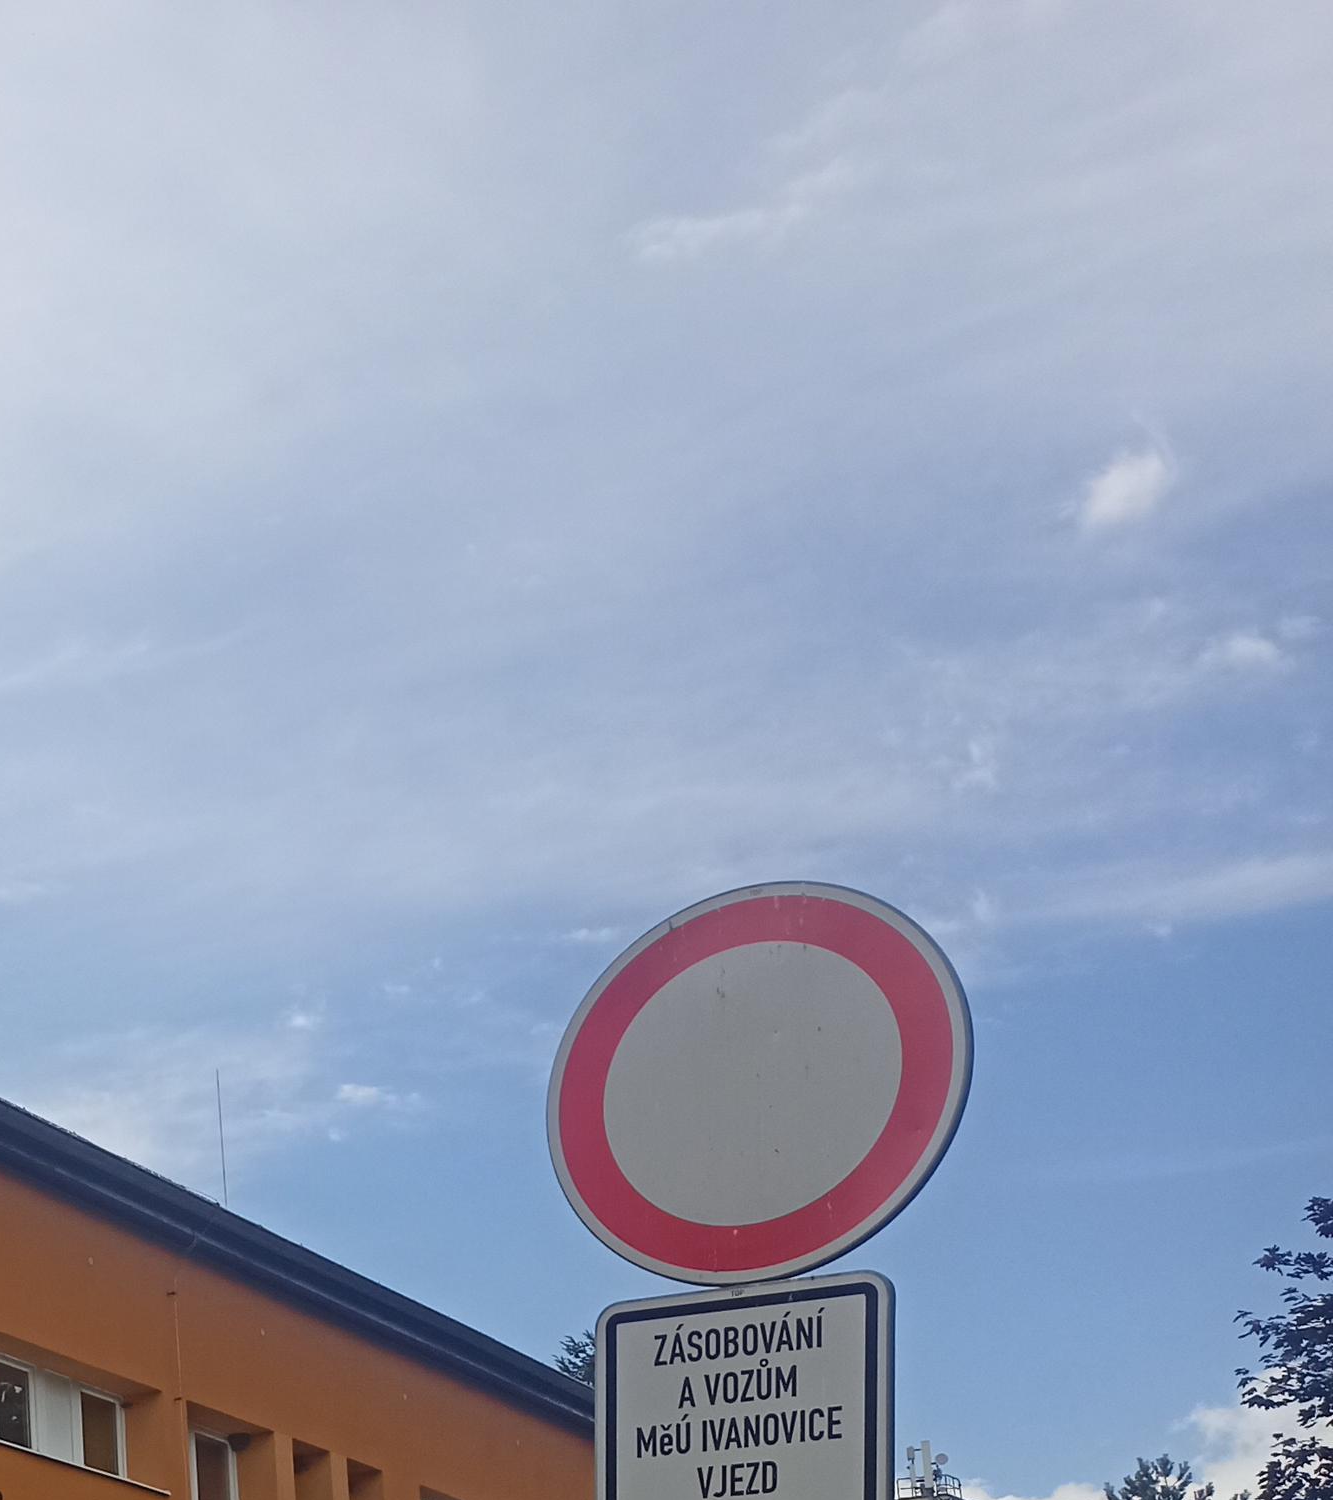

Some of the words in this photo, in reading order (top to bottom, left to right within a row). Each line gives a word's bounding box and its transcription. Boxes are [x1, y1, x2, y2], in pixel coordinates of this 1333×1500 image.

[653, 1307, 825, 1367] ZÁSOBOVÁNÍ
[677, 1377, 696, 1410] A
[703, 1358, 797, 1406] VOZŮM
[636, 1413, 691, 1459] MěÚ
[701, 1406, 843, 1453] IVANOVICE
[696, 1461, 778, 1499] VJEZD
